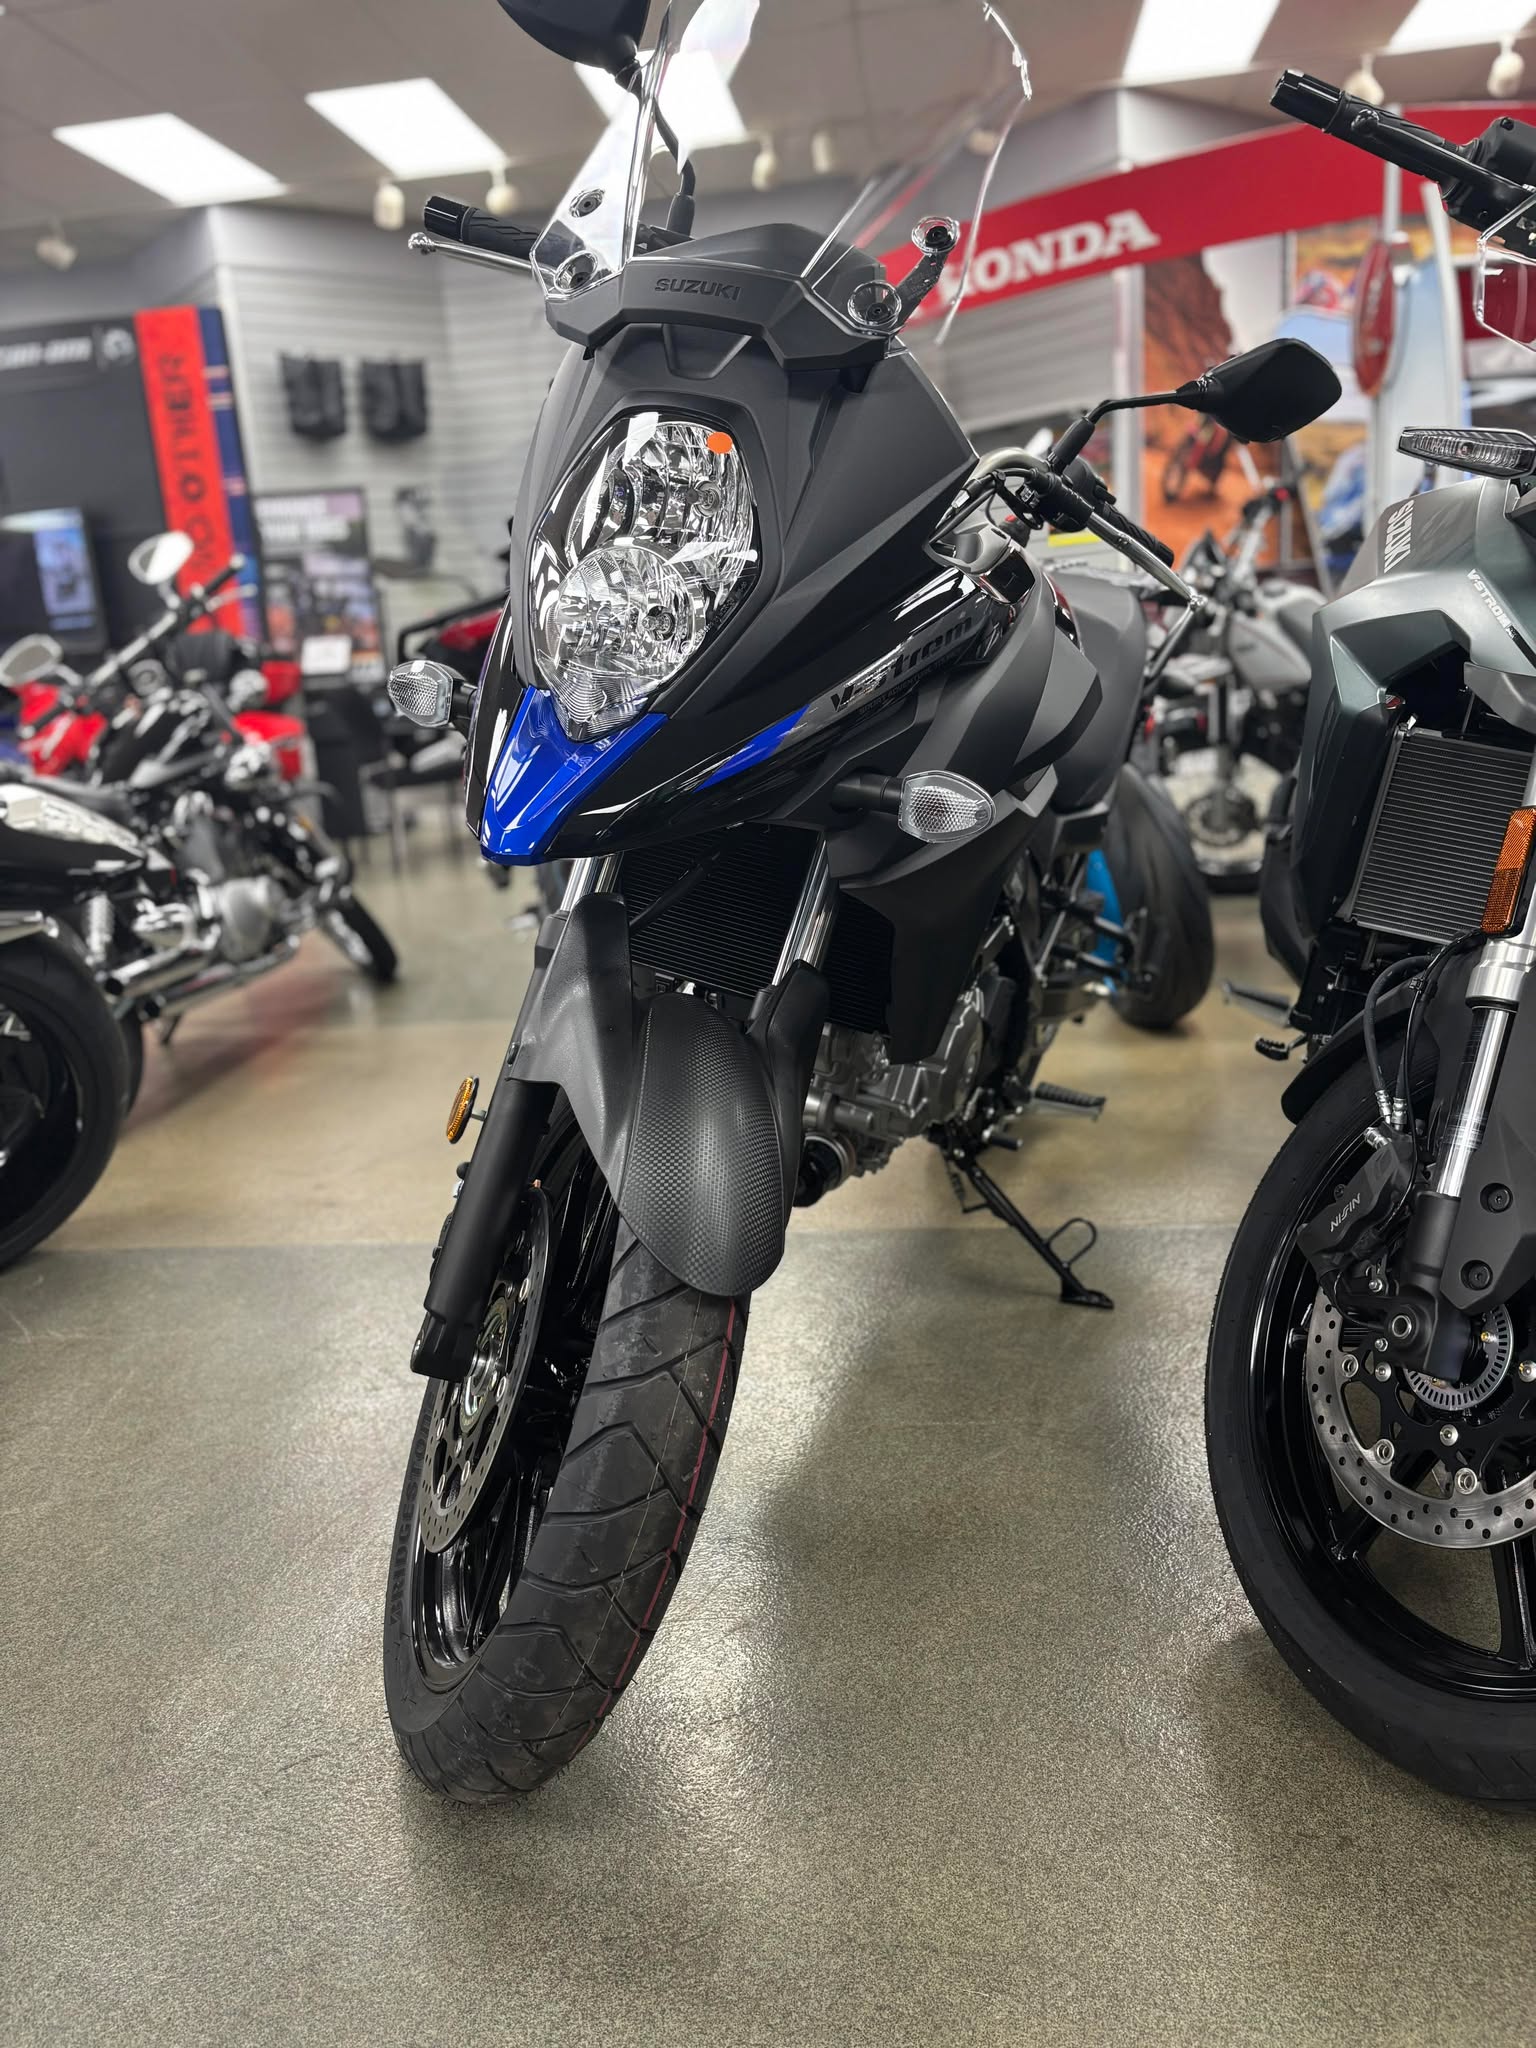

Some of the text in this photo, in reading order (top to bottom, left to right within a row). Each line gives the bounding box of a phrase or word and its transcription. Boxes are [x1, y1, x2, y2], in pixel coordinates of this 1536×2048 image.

[654, 277, 742, 301] SUZUKI
[936, 209, 1160, 300] HONDA
[1383, 499, 1415, 574] SUZUKI
